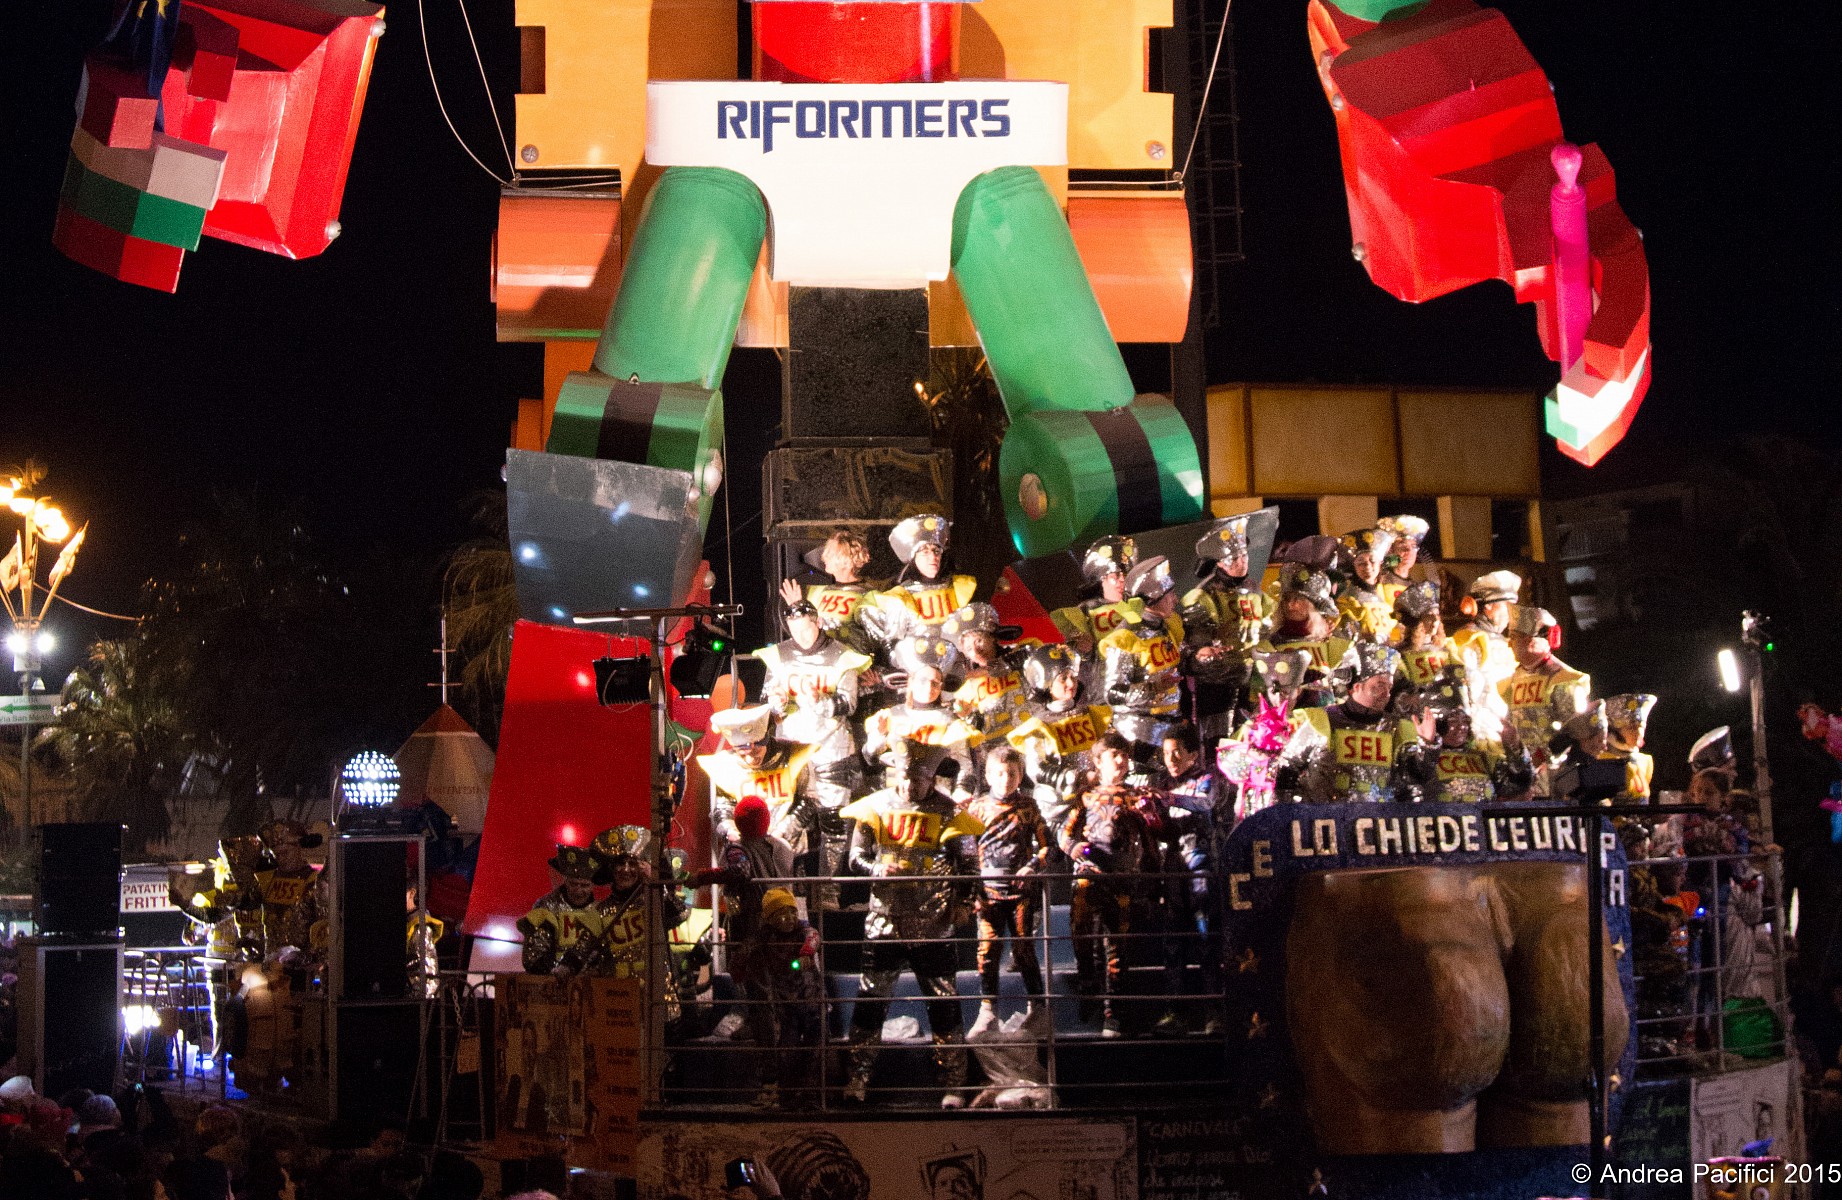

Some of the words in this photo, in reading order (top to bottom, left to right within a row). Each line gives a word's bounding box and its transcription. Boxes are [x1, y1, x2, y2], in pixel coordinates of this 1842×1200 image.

[717, 98, 1011, 154] RIFORMERS
[1513, 679, 1544, 705] CISL
[1344, 735, 1387, 762] SEL
[887, 813, 933, 843] UIL
[1290, 818, 1339, 857] LO
[1355, 814, 1480, 855] CHIEDE
[123, 883, 169, 895] PATATIN
